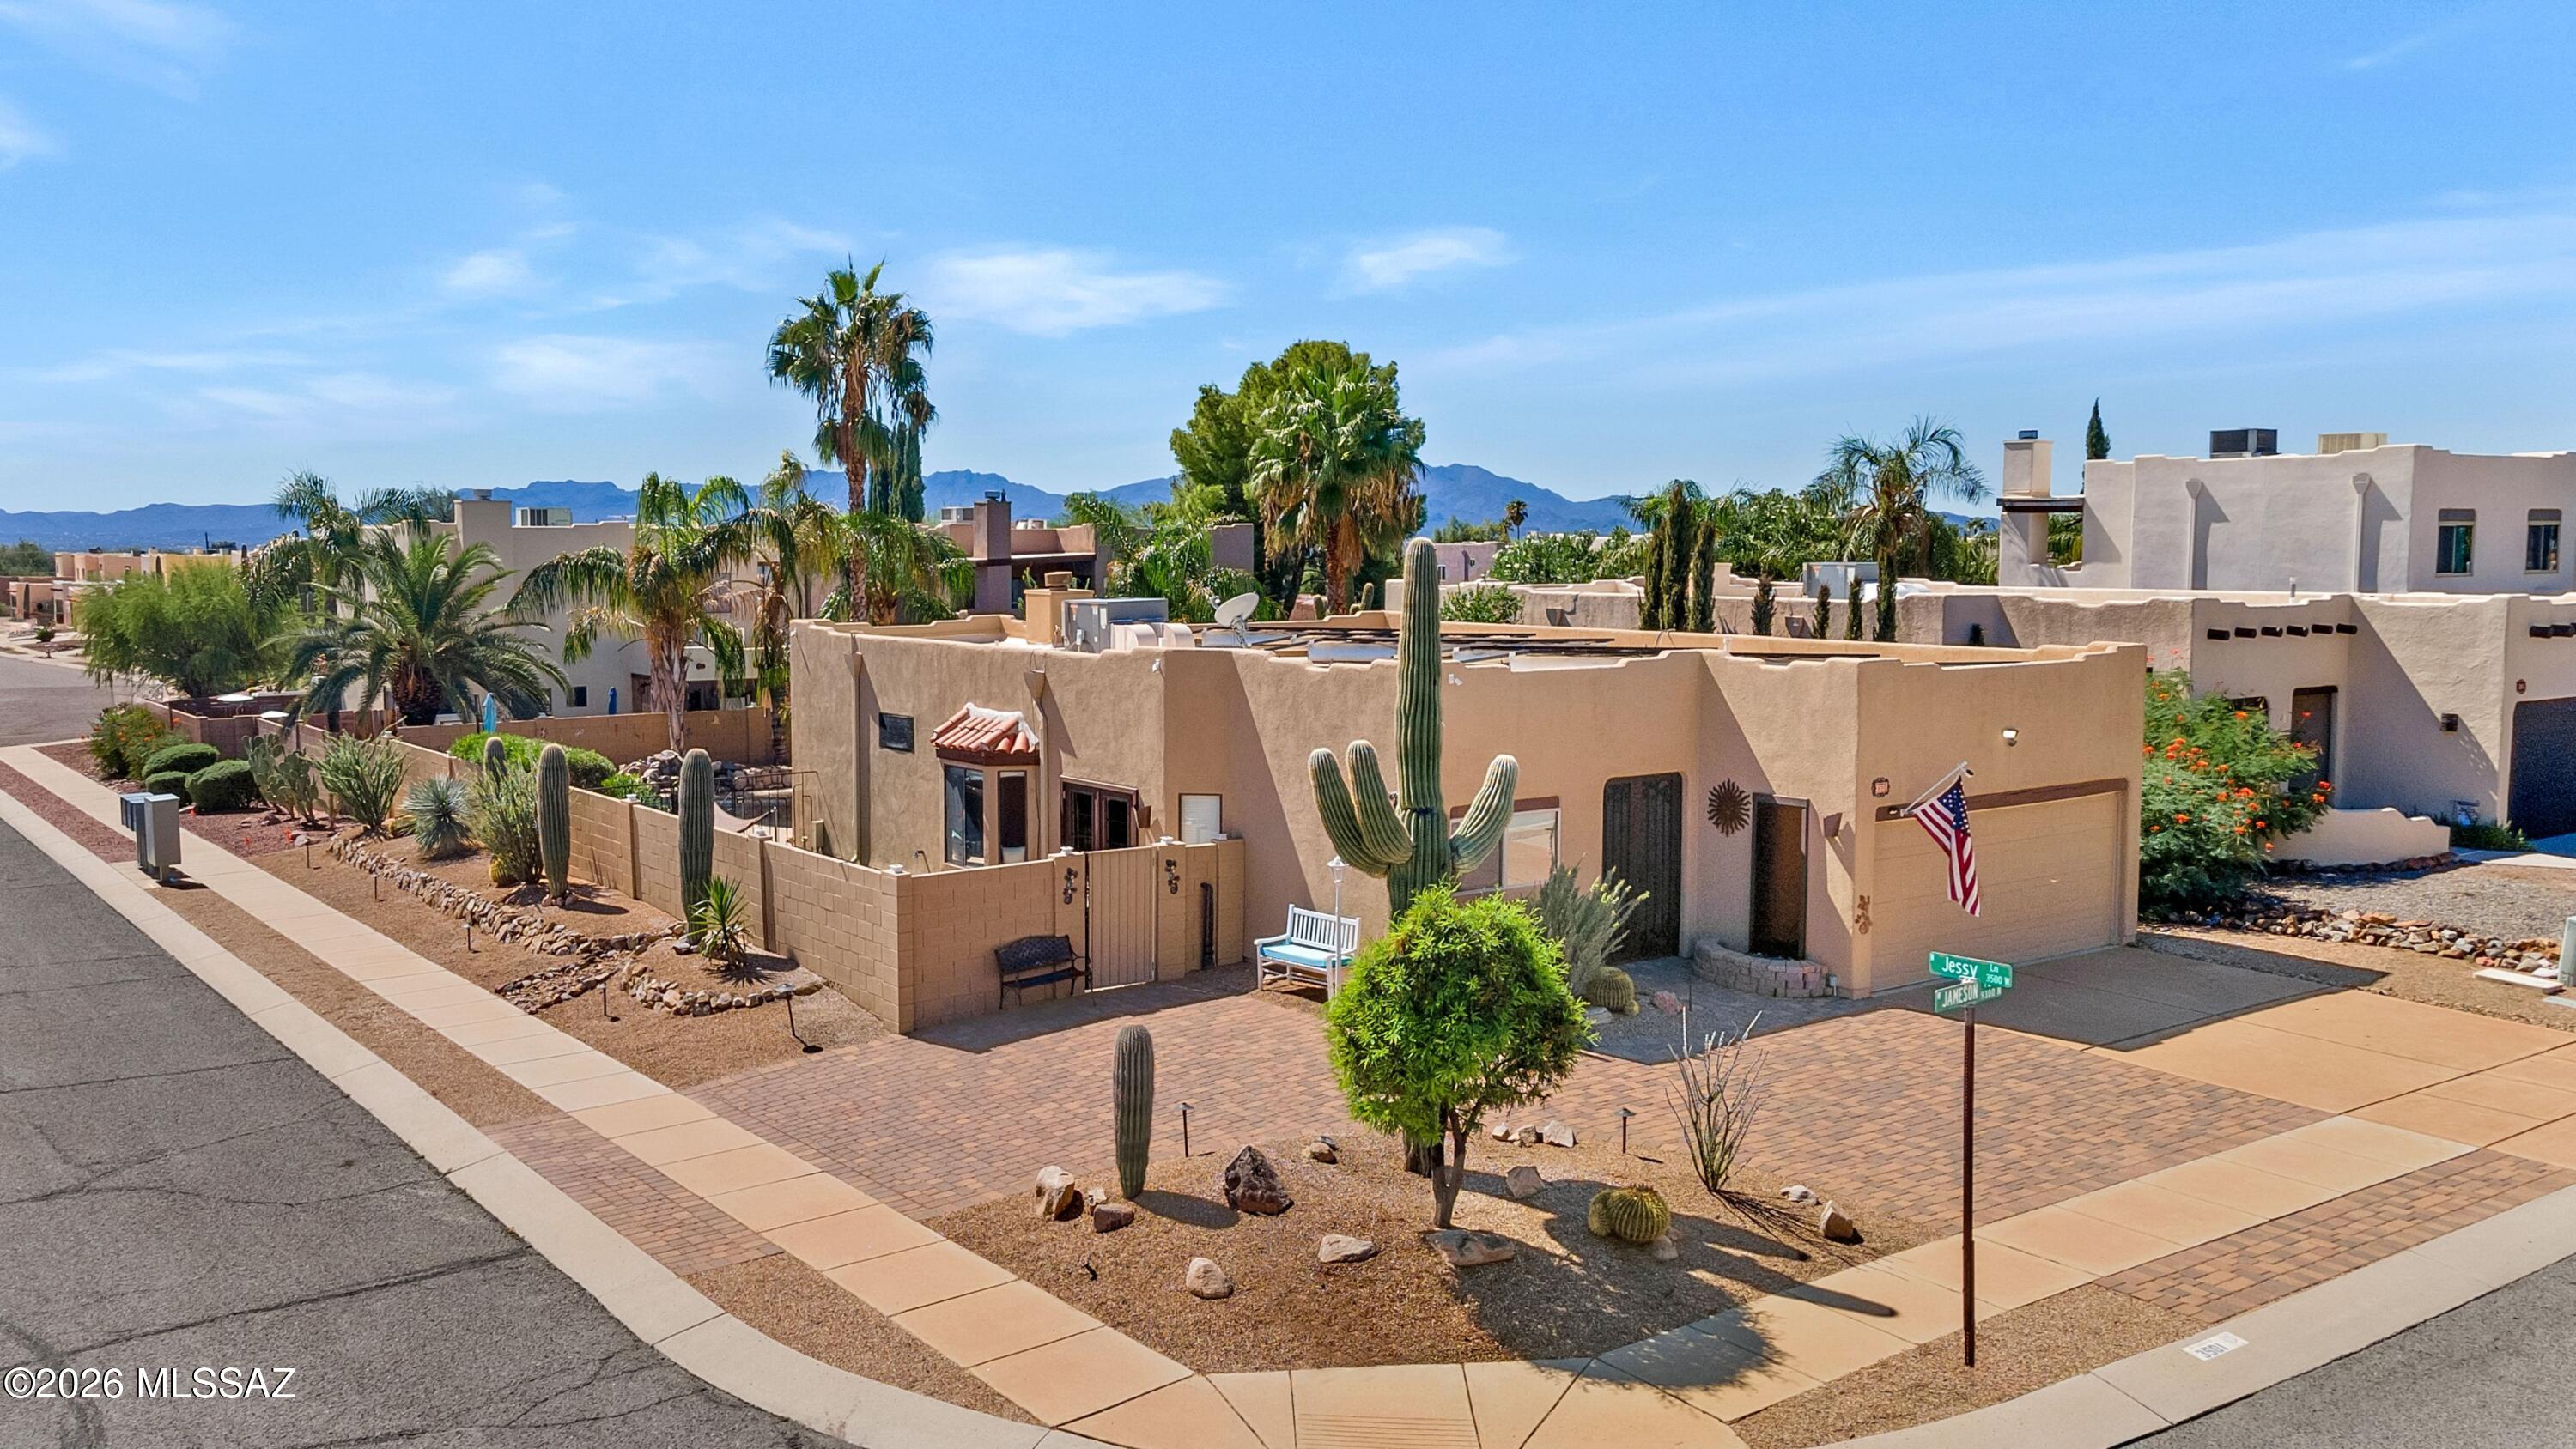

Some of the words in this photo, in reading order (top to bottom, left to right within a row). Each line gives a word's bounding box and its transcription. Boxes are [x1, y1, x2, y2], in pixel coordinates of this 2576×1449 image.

[1941, 956, 1978, 978] Jessy
[1990, 963, 1999, 973] Ln
[1985, 973, 2002, 985] 3500
[1942, 982, 1978, 1007] JAMESON
[2195, 1343, 2228, 1358] 3501
